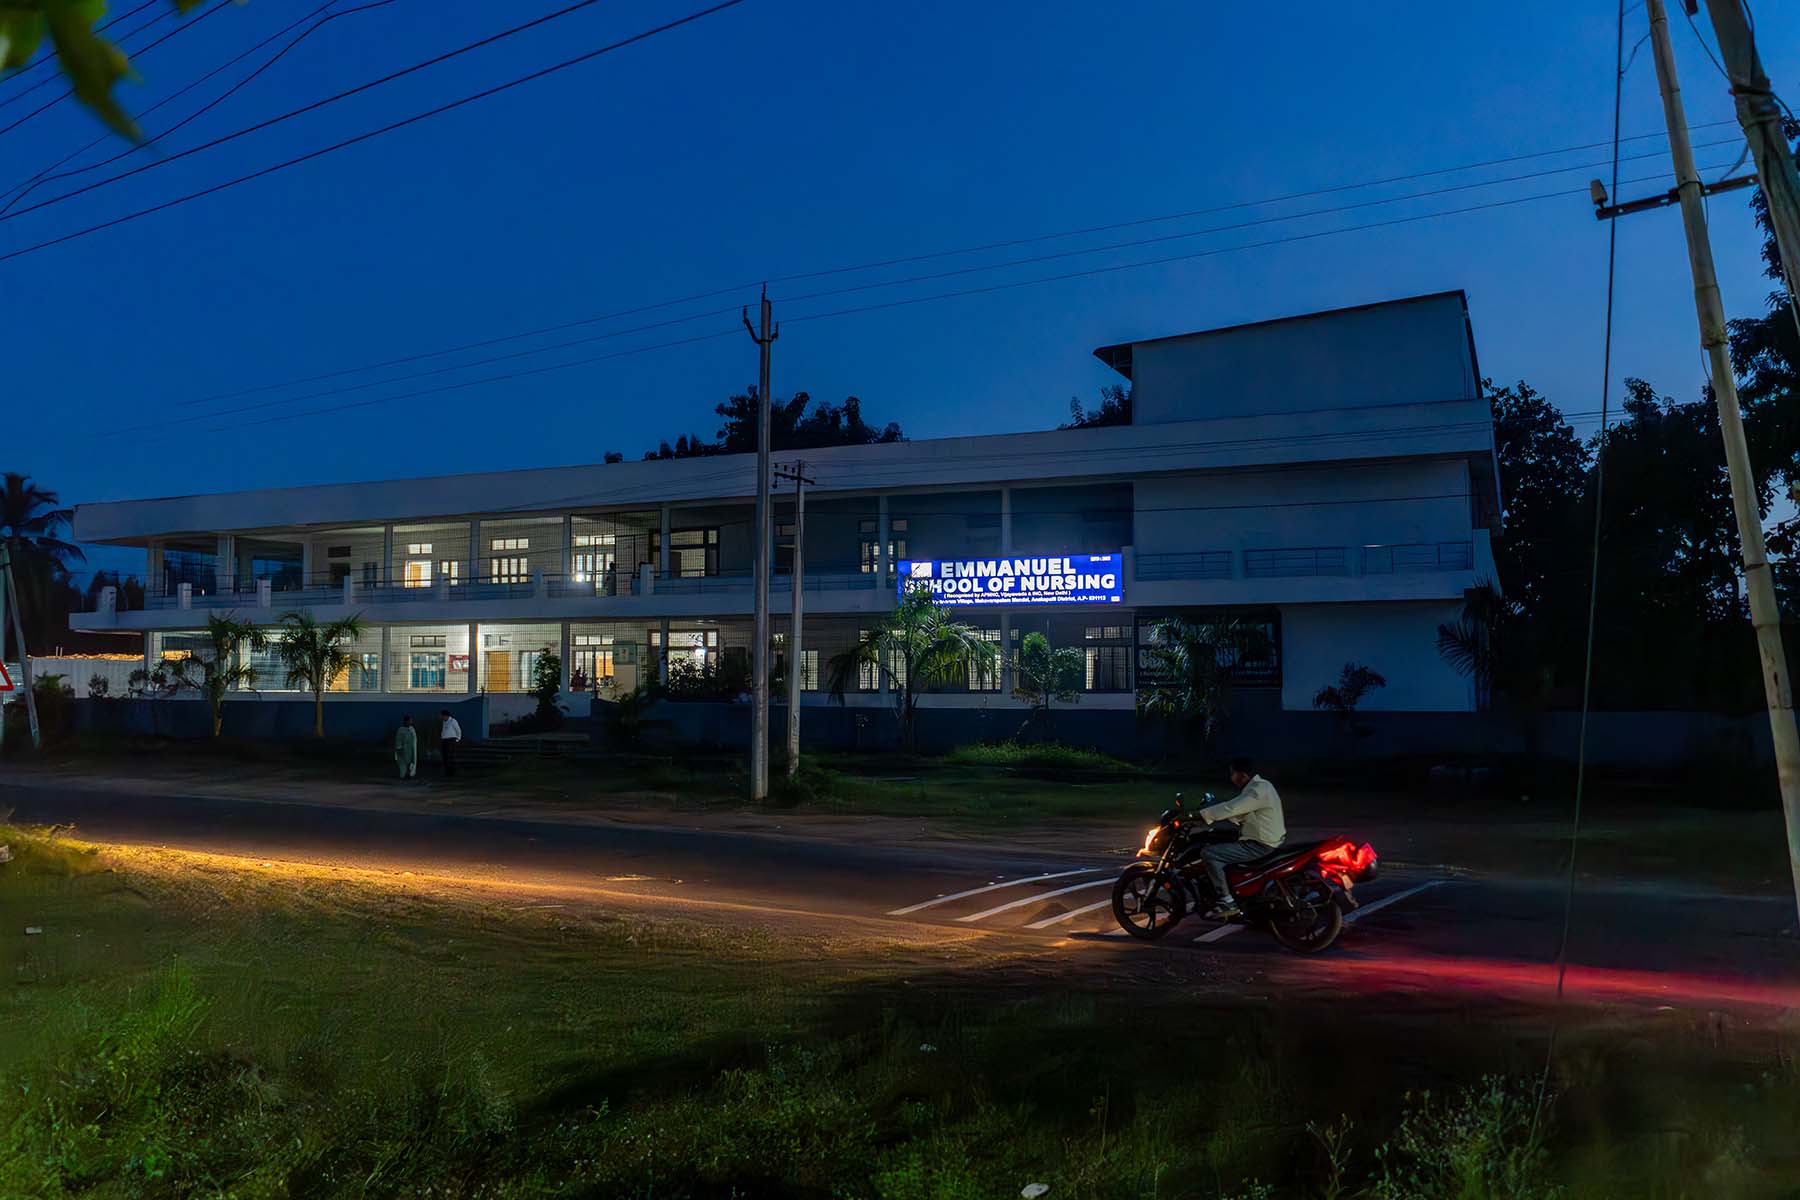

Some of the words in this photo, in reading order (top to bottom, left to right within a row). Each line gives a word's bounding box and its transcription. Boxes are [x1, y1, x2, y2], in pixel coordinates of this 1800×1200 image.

[941, 558, 1076, 577] EMMANUEL
[988, 578, 1015, 592] OF
[1020, 574, 1115, 591] NURSING
